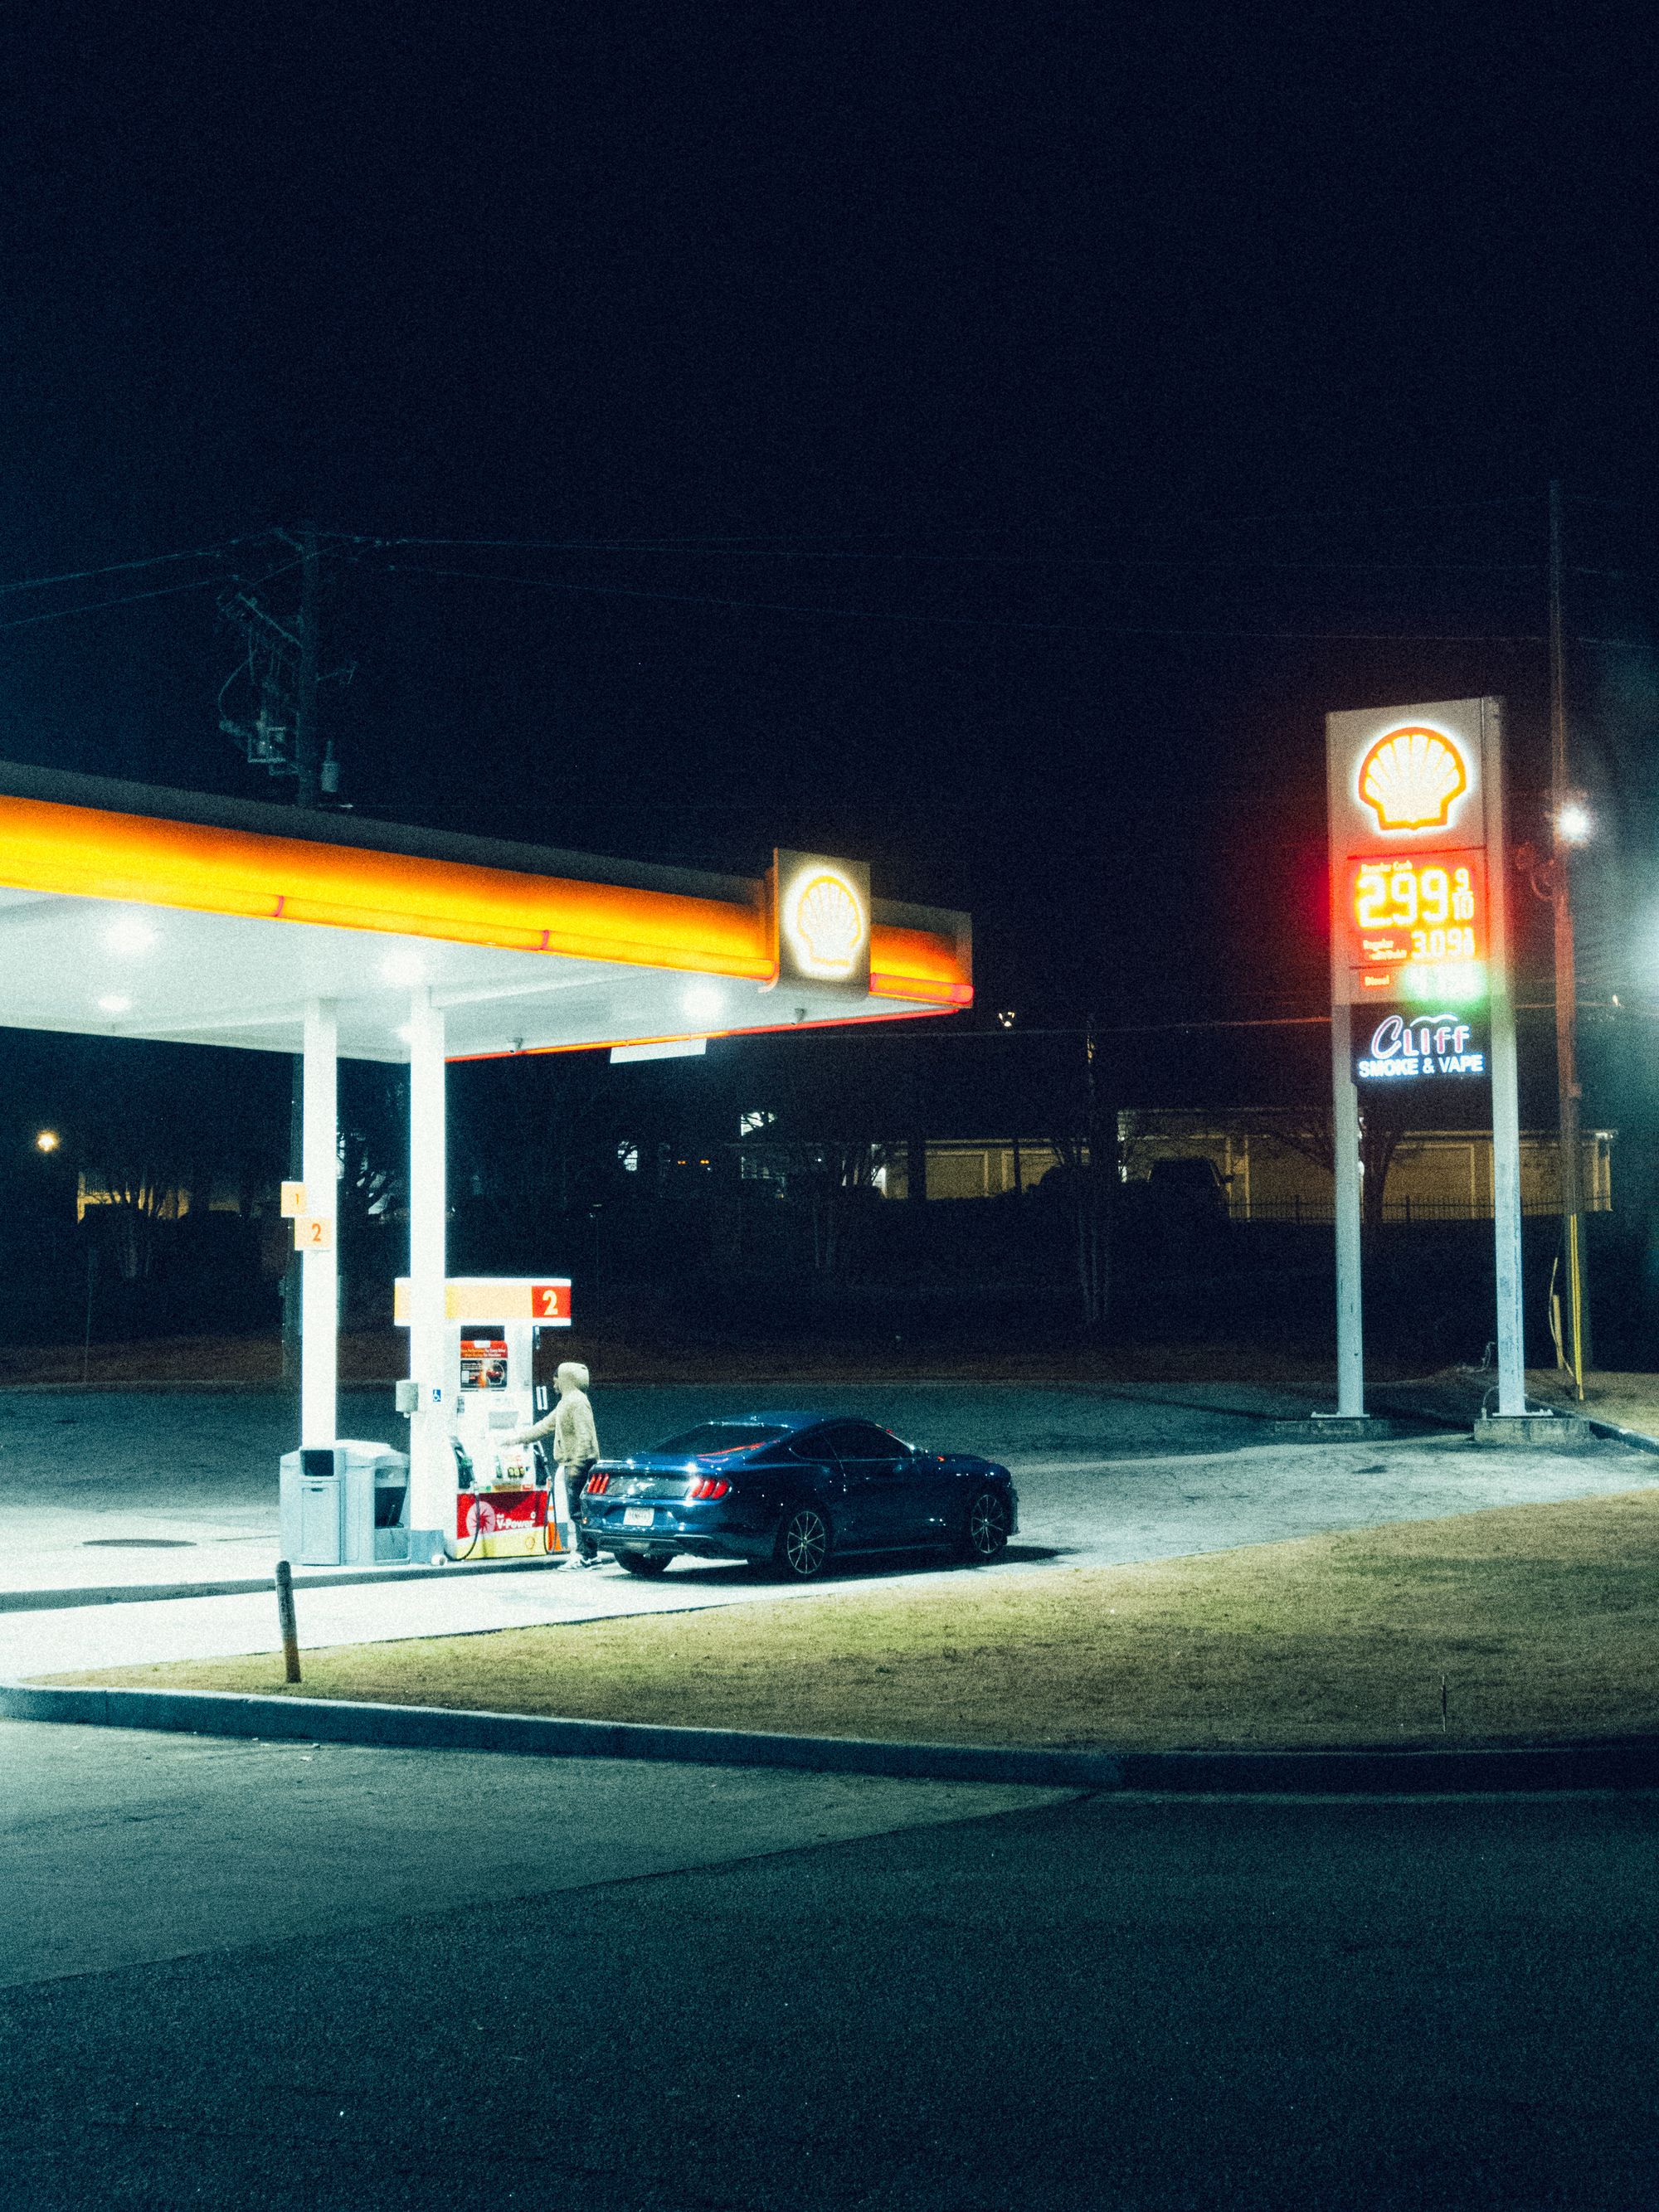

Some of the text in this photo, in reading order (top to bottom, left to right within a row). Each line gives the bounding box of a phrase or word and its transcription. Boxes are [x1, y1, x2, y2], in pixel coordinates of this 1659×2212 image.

[1359, 1054, 1483, 1077] SMOKE & VAPE
[311, 1223, 322, 1242] 2
[542, 1289, 558, 1316] 2
[497, 1518, 536, 1529] V-Power
